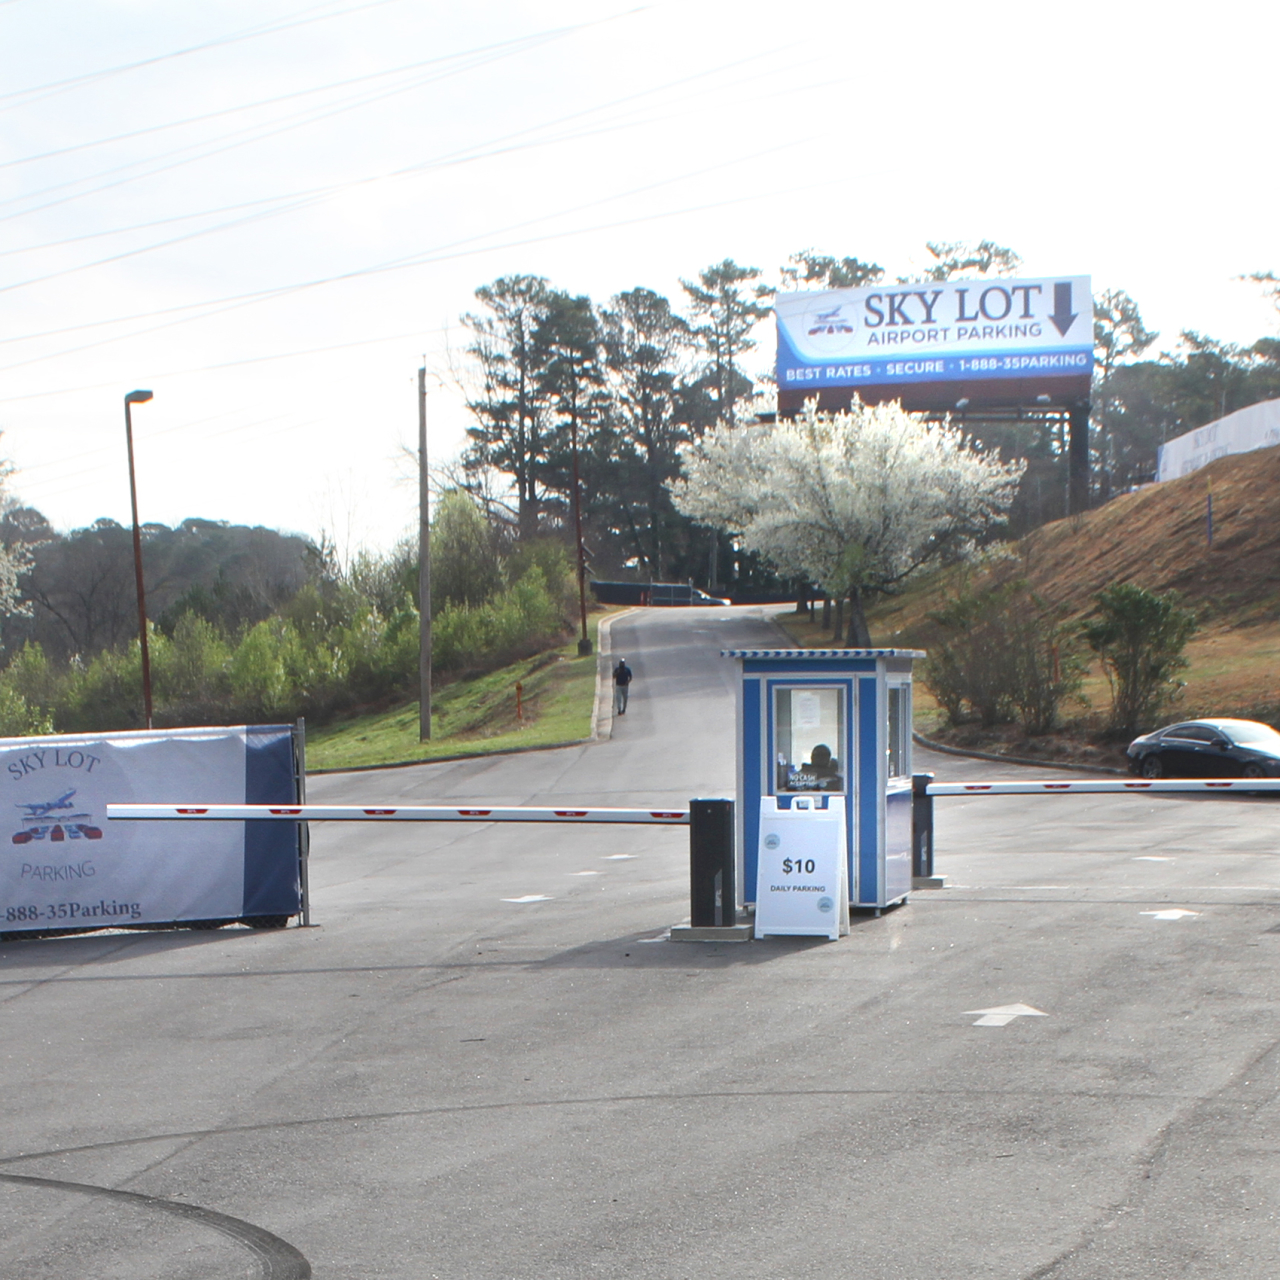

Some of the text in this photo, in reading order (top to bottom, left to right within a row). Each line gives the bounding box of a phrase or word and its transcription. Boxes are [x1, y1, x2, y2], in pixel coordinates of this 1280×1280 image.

[864, 284, 1043, 328] SKY LOT
[867, 322, 1042, 346] AIRPORT PARKING
[786, 354, 1087, 381] BEST RATES SECURE 1-888-35PARKING
[8, 749, 101, 781] SKY LOT
[20, 860, 96, 881] PARKING
[782, 857, 816, 876] $10
